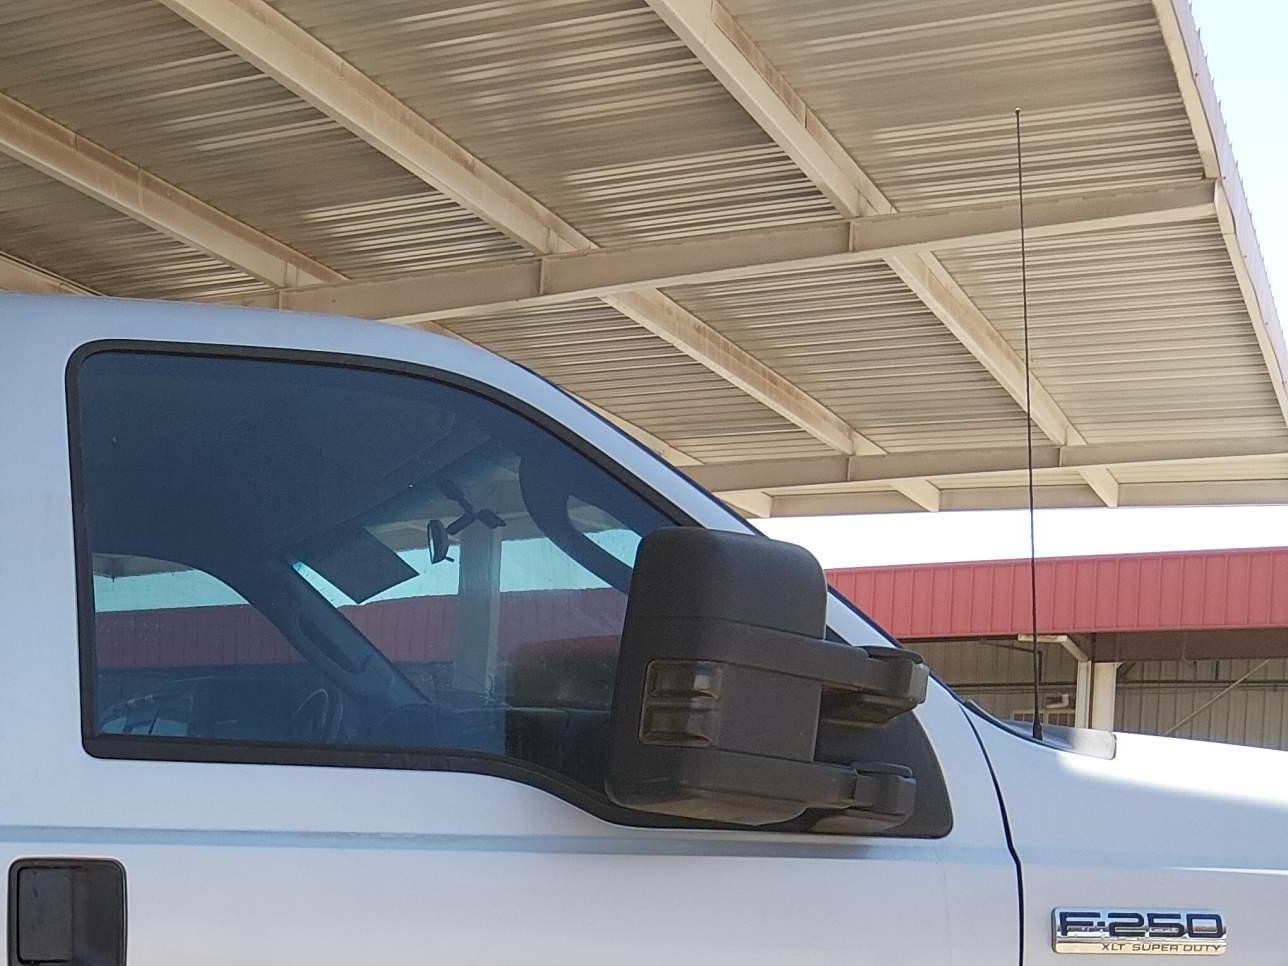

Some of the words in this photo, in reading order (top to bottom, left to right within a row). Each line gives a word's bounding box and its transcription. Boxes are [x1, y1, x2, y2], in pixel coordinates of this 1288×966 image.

[1059, 911, 1224, 939] F-250
[1101, 943, 1126, 951] XLT
[1131, 943, 1179, 952] SUPER
[1183, 944, 1221, 953] DUTY
